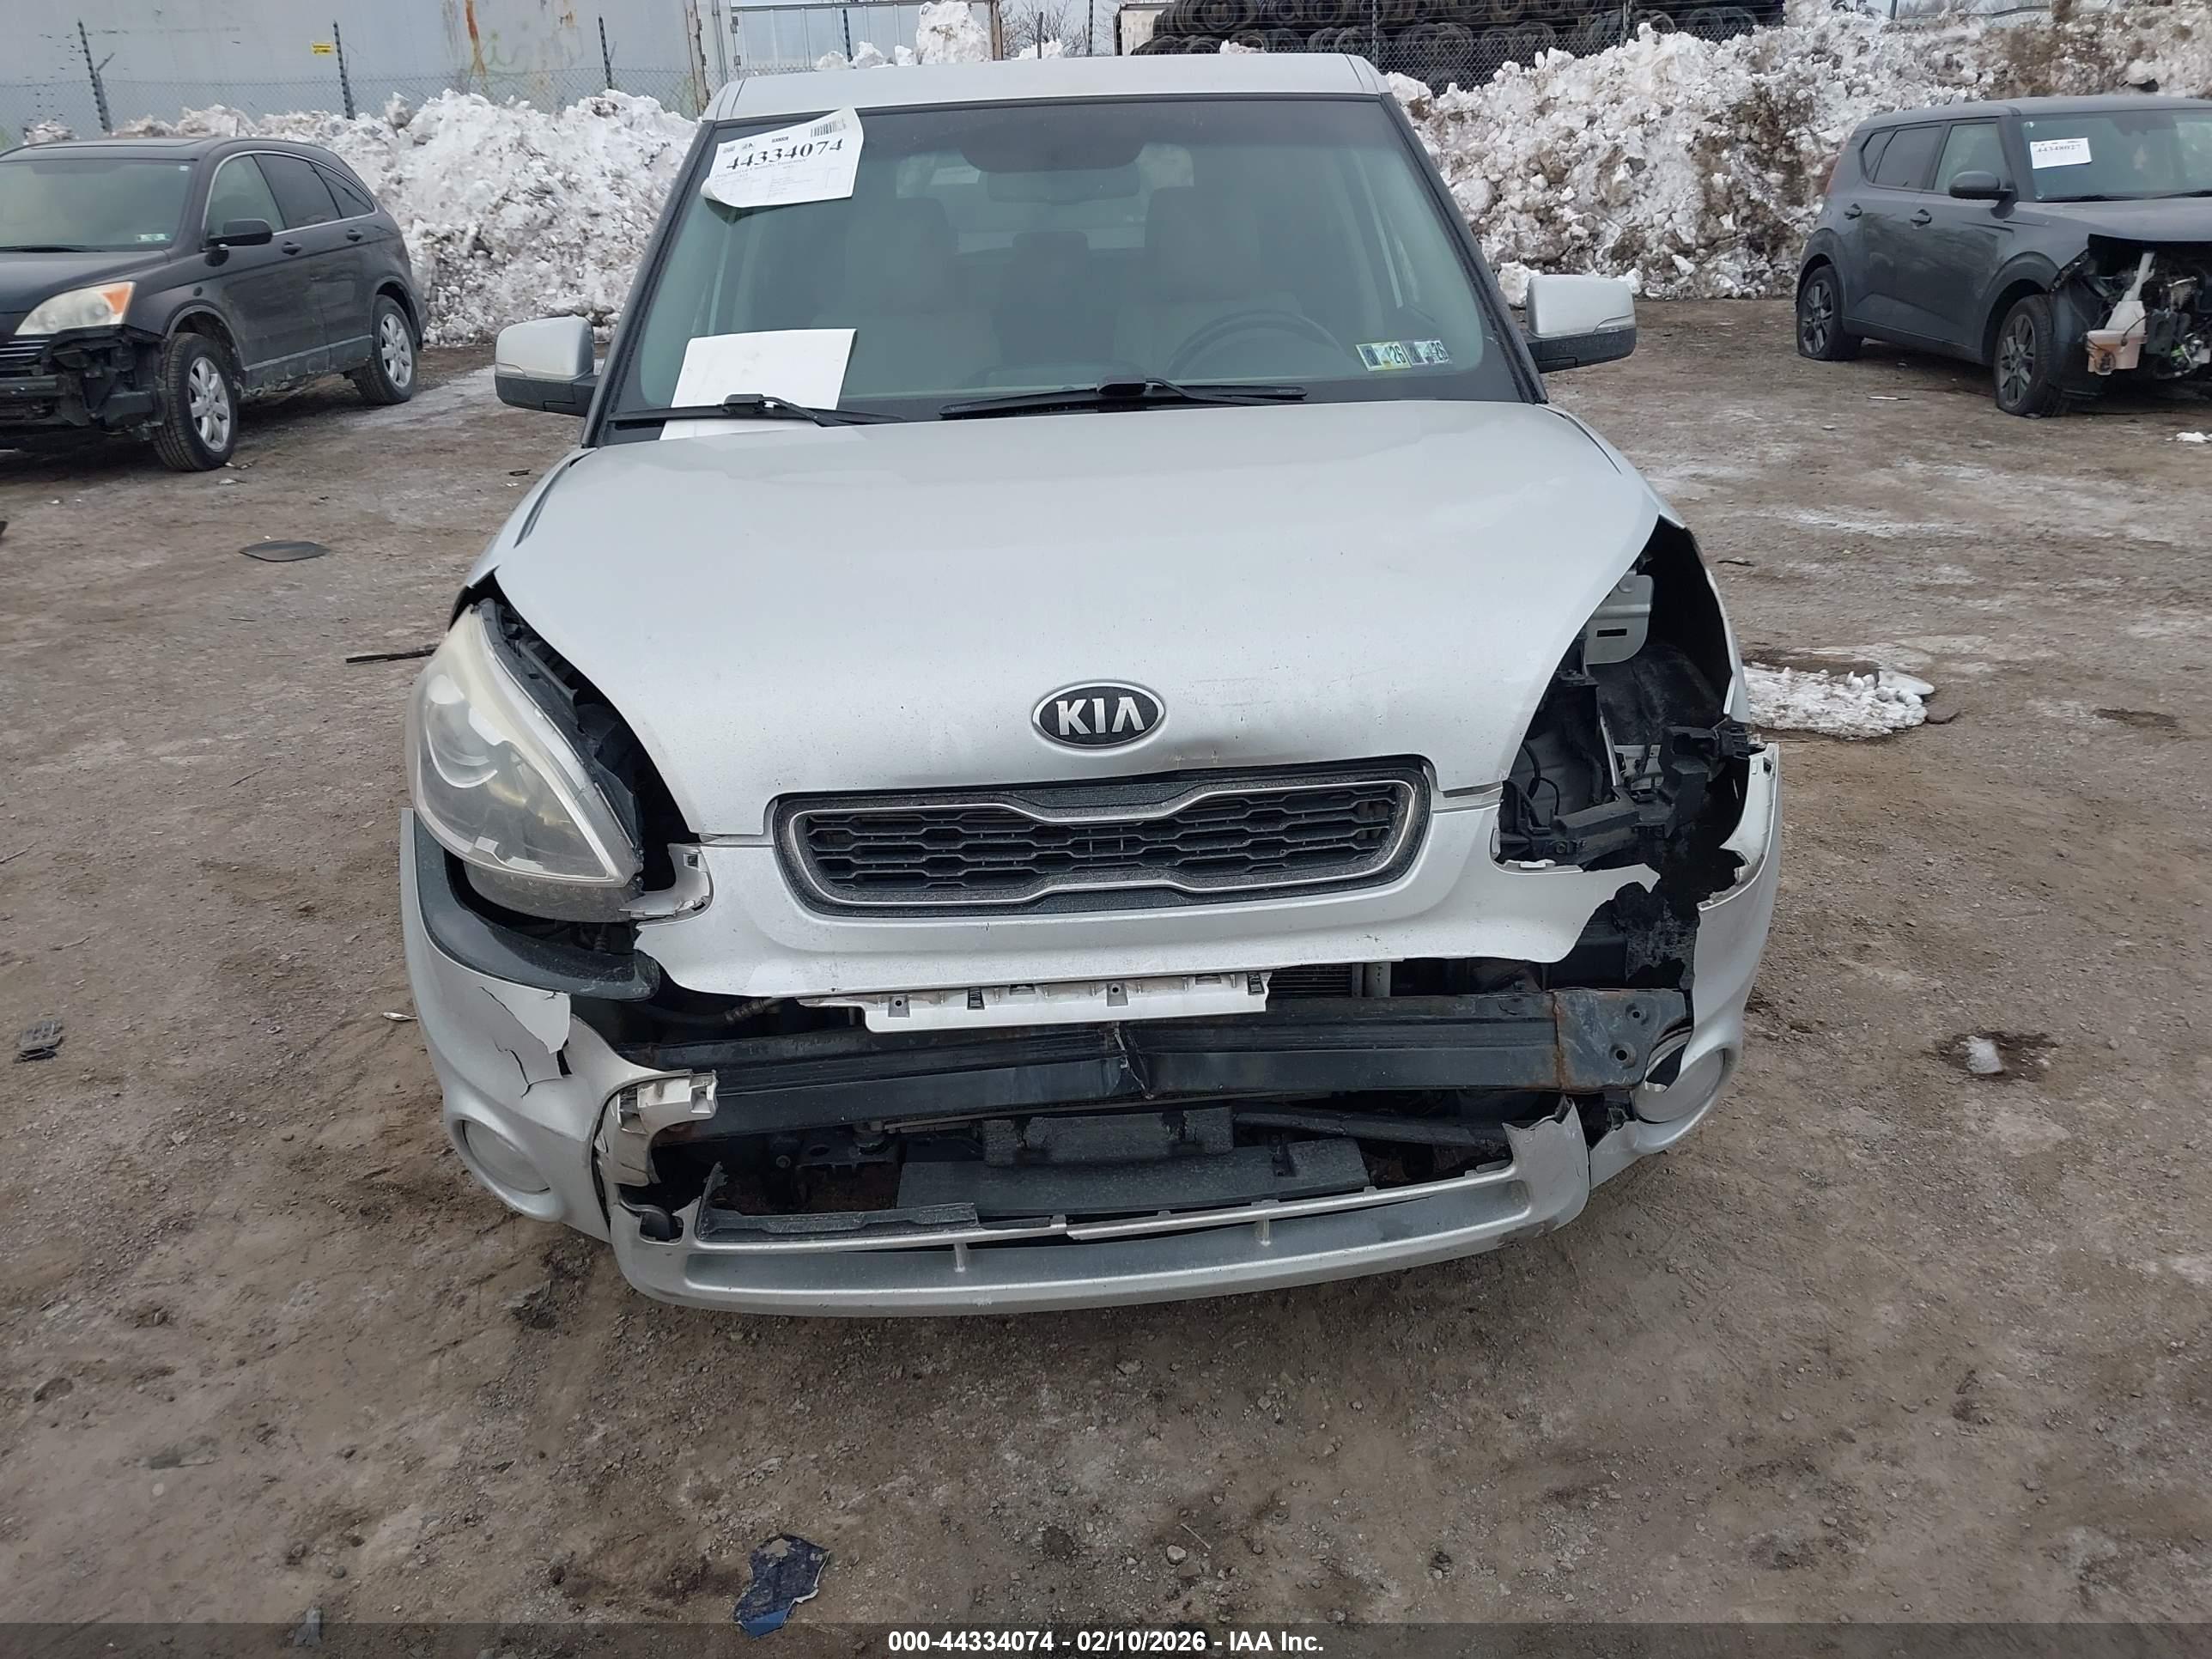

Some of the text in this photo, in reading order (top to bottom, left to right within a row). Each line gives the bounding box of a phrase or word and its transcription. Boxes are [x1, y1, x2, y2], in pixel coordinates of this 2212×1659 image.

[726, 138, 843, 170] 44334074
[1389, 344, 1407, 364] 26
[1056, 696, 1146, 736] KIA
